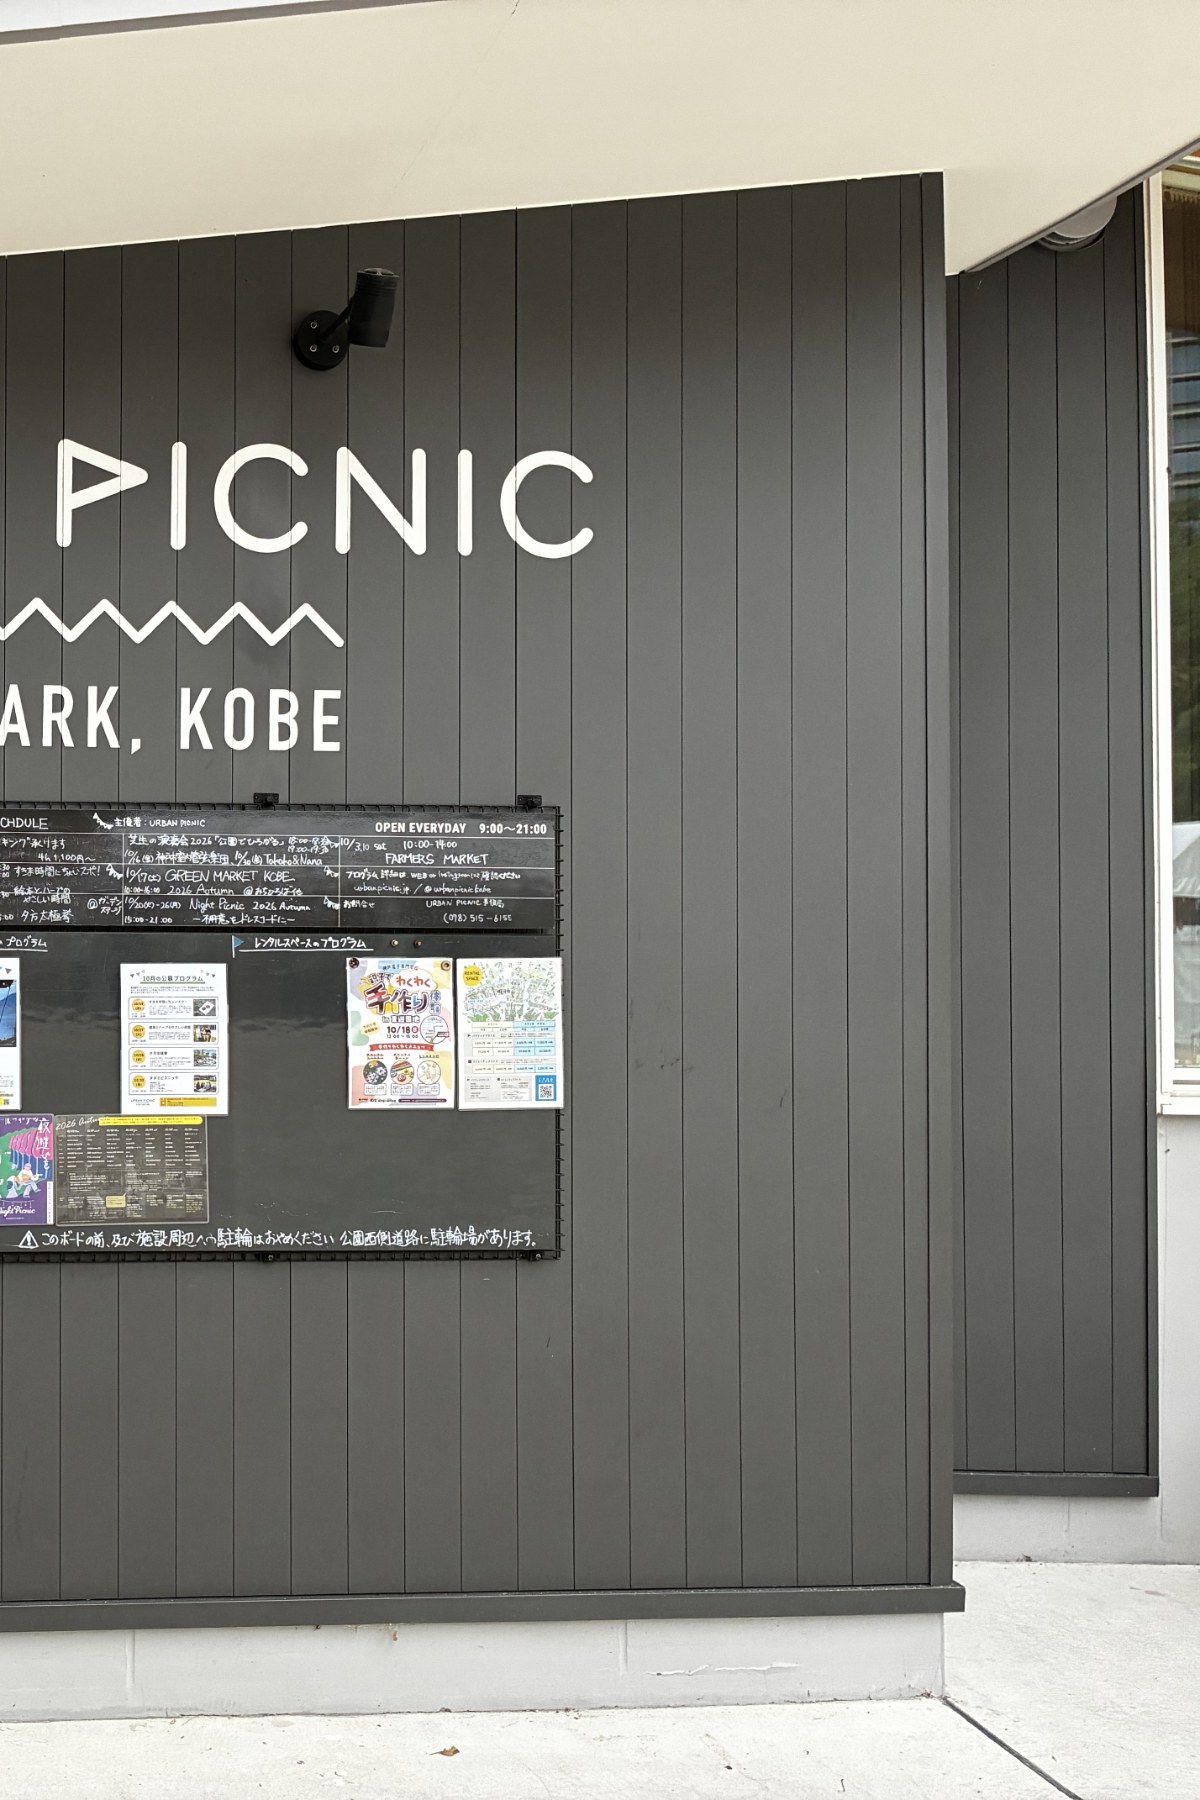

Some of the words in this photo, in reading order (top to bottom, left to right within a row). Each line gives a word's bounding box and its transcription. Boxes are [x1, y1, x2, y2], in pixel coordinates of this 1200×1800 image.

[56, 437, 593, 559] PICNIC
[179, 686, 342, 751] KOBE
[149, 819, 178, 827] URBAN
[180, 819, 206, 827] PICNIC
[375, 822, 406, 833] OPEN
[409, 822, 467, 834] EVERYDAY
[385, 853, 434, 865] FARMERS
[443, 853, 489, 865] MARKET
[164, 869, 209, 882] GREEN
[213, 870, 258, 883] MARKET
[263, 870, 295, 882] KOBE
[189, 897, 215, 914] Night
[218, 897, 245, 910] Picnic
[252, 901, 277, 910] 2026
[426, 899, 453, 908] URBAN
[395, 975, 431, 987] わくわく
[365, 983, 428, 1014] 手作り
[387, 1026, 411, 1034] 10/18
